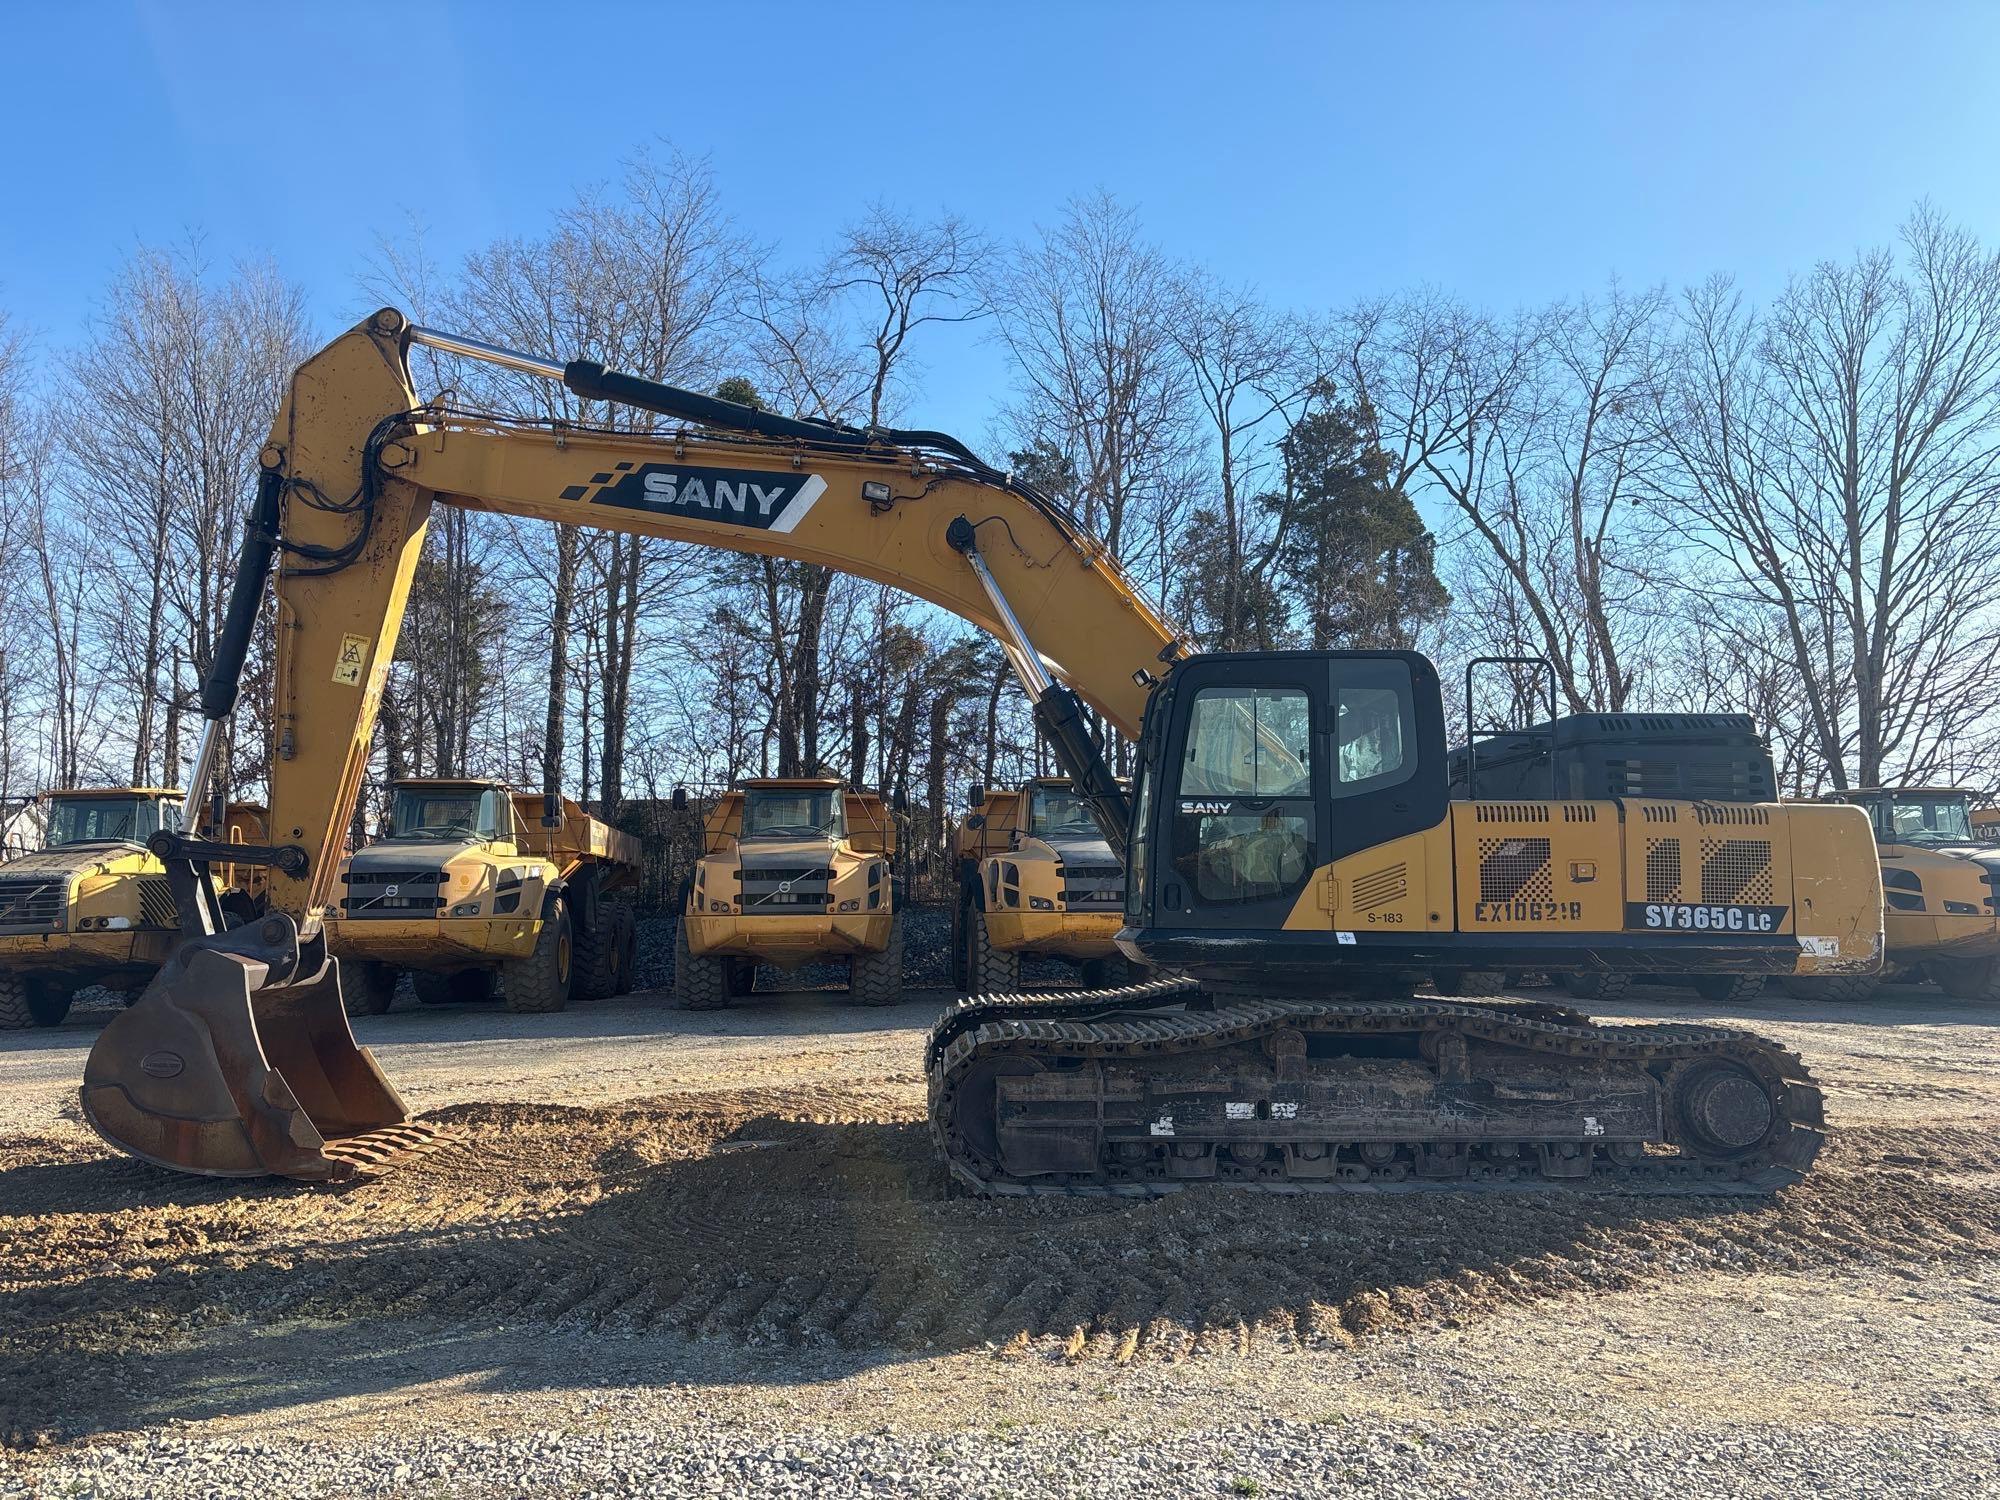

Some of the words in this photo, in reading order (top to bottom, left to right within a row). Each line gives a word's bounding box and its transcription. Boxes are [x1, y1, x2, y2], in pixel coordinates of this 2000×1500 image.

[643, 472, 786, 515] SANY
[1181, 802, 1231, 814] SANY
[1367, 912, 1403, 923] S-183
[1645, 905, 1743, 930] SY365C
[1747, 913, 1771, 931] LC
